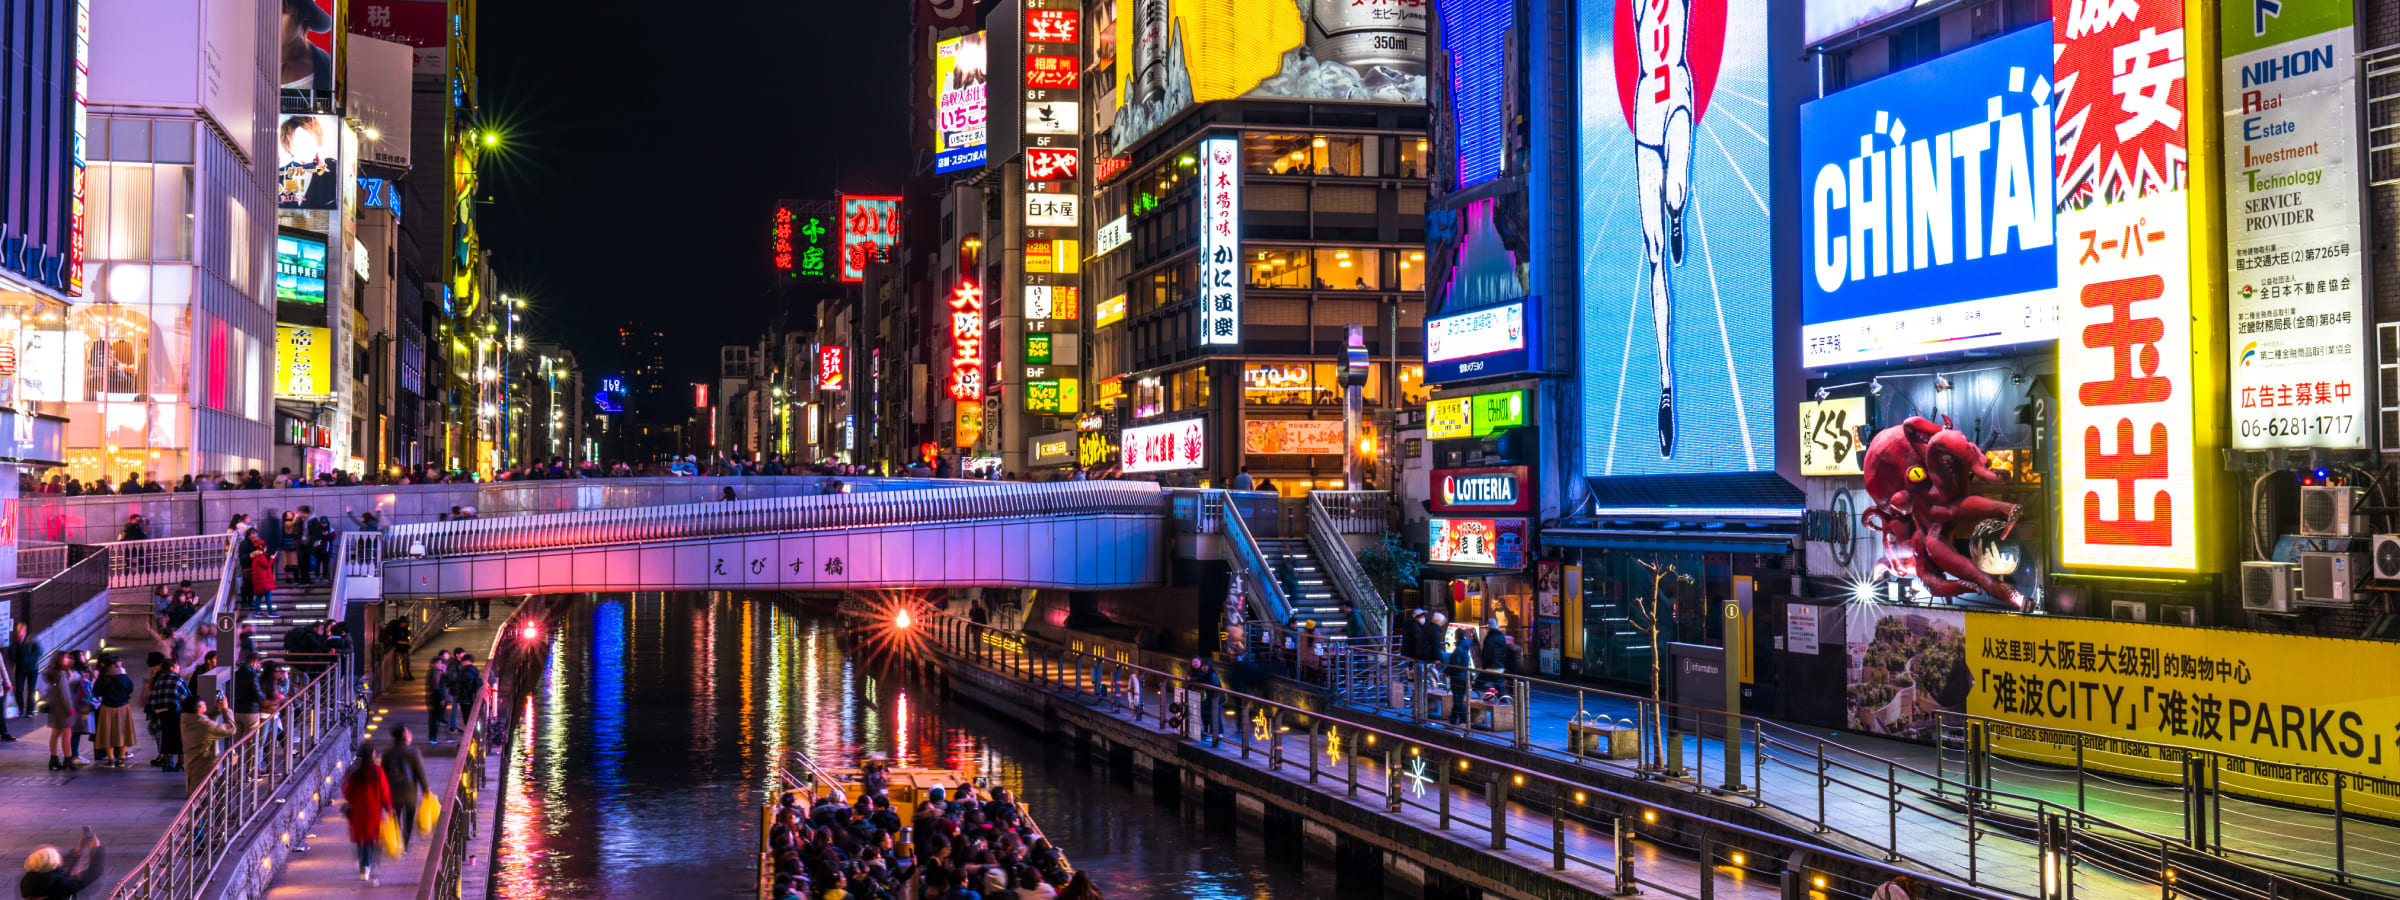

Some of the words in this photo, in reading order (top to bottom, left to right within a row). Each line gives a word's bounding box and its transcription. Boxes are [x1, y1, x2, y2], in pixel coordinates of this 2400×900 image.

[1028, 44, 1045, 54] 7F
[1374, 36, 1408, 50] 350ml
[2241, 44, 2333, 88] NIHON
[1027, 71, 1078, 86] ダイニング
[1028, 90, 1046, 100] 6F
[2242, 90, 2282, 115] Real
[2243, 116, 2296, 142] Estate
[1036, 137, 1051, 146] 5F
[938, 152, 986, 168] 店舗・スタッフ求人
[2244, 141, 2319, 168] Investment
[280, 164, 327, 178] ーグループ
[1813, 66, 2053, 293] CHINTAI
[2242, 169, 2322, 193] Technology
[1027, 182, 1046, 192] 4F
[1029, 198, 1075, 217] 白木屋
[1216, 171, 1231, 237] 本場の味
[2245, 192, 2302, 214] SERVICE
[2246, 208, 2314, 232] PROVIDER
[776, 207, 792, 269] お好み焼
[802, 218, 826, 270] 千房
[1027, 228, 1045, 238] 3F
[2079, 216, 2166, 267] スーパー
[2236, 243, 2350, 271] 国土交通大臣(2)第7265号
[1027, 276, 1045, 284] 2F
[2260, 276, 2350, 300] 全日本不動産協会
[1028, 321, 1045, 331] 1F
[2238, 311, 2351, 335] 近畿財務局長(金商)第84号
[949, 281, 982, 399] 大阪王将
[831, 348, 840, 373] ツルハ
[2241, 379, 2351, 409] 広告主募集中
[2078, 274, 2173, 548] 玉出
[1812, 409, 1853, 464] くくる
[2241, 415, 2352, 437] 06-6281-1717
[1456, 477, 1511, 501] LOTTERIA
[714, 557, 844, 576] えびす橋
[1692, 663, 1719, 675] information
[1982, 669, 2400, 765] 「难波CITY」「难波PARKS」
[1984, 721, 2013, 740] argest
[2015, 727, 2037, 742] class
[2038, 729, 2077, 751] shopping
[2159, 745, 2193, 765] Nama
